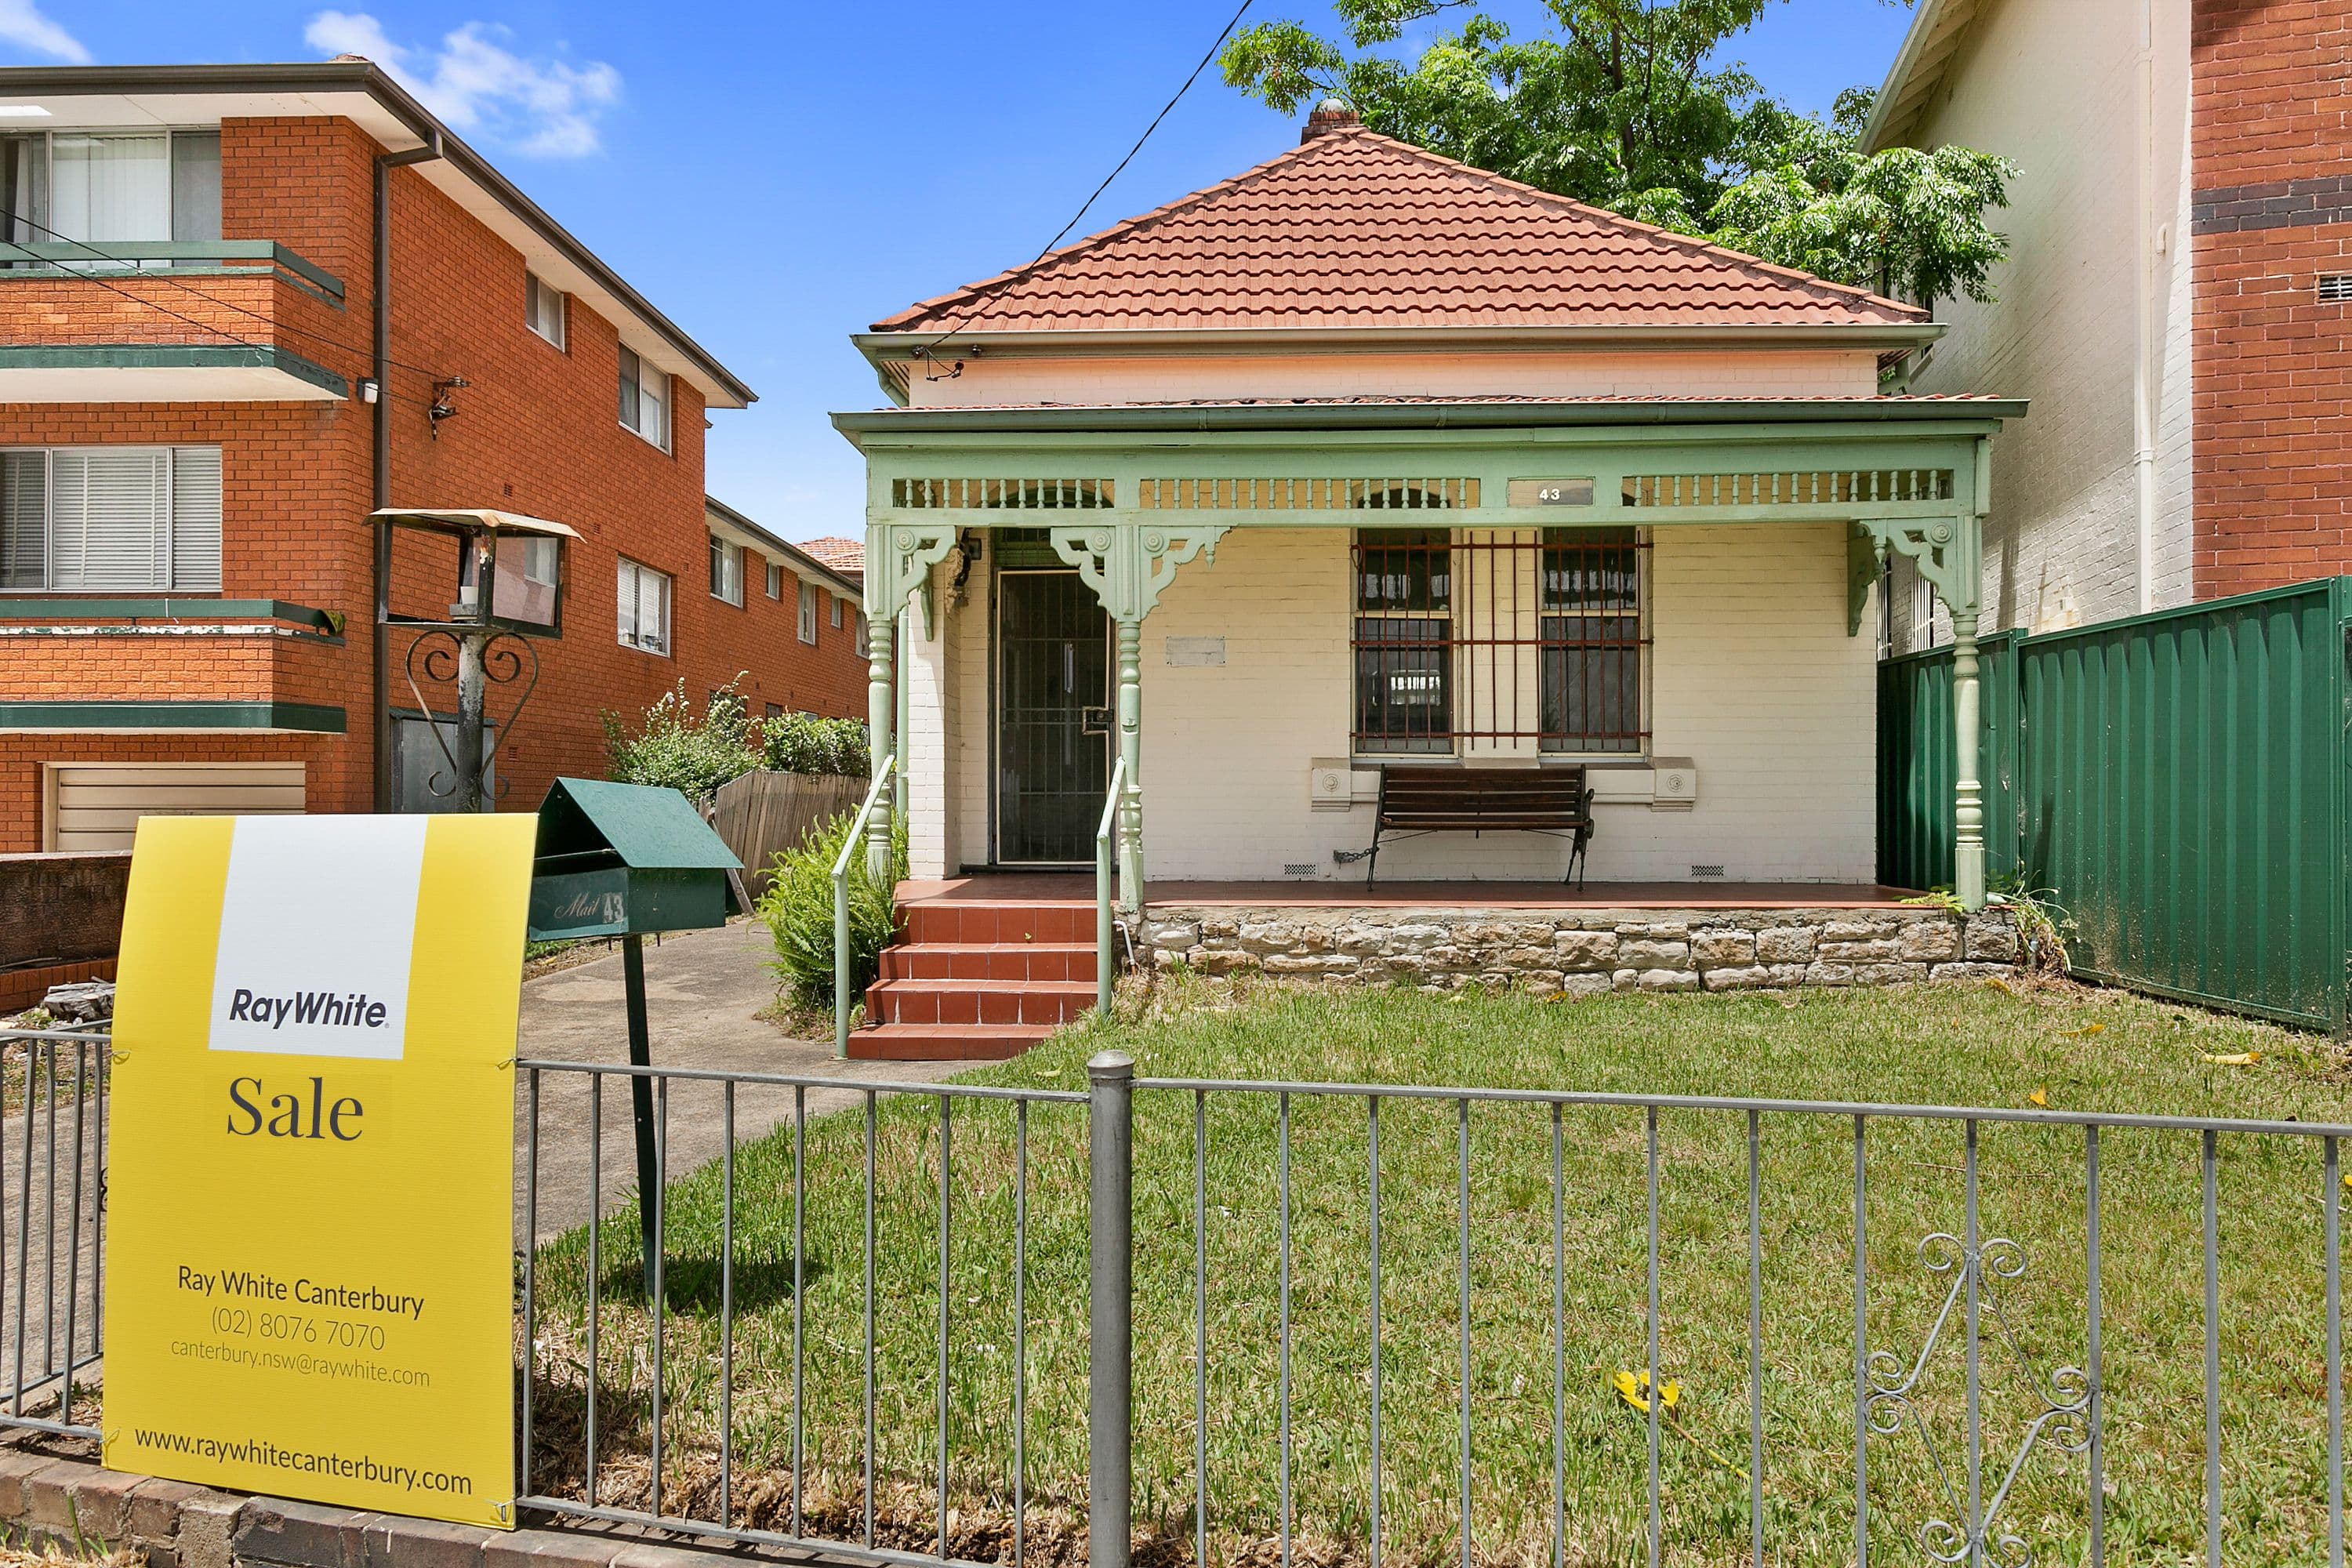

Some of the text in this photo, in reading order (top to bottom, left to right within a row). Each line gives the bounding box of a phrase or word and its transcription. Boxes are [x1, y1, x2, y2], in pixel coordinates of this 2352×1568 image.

[1539, 488, 1560, 500] 43
[554, 892, 624, 923] Mail 43
[227, 1076, 364, 1142] Sale
[179, 1265, 425, 1321] Ray White Canterbury
[212, 1305, 385, 1351] (02) 8076 7070
[171, 1340, 430, 1387] canterbury.nsw@raywhite.com
[134, 1428, 472, 1496] www.raywhitecanterbury.com
